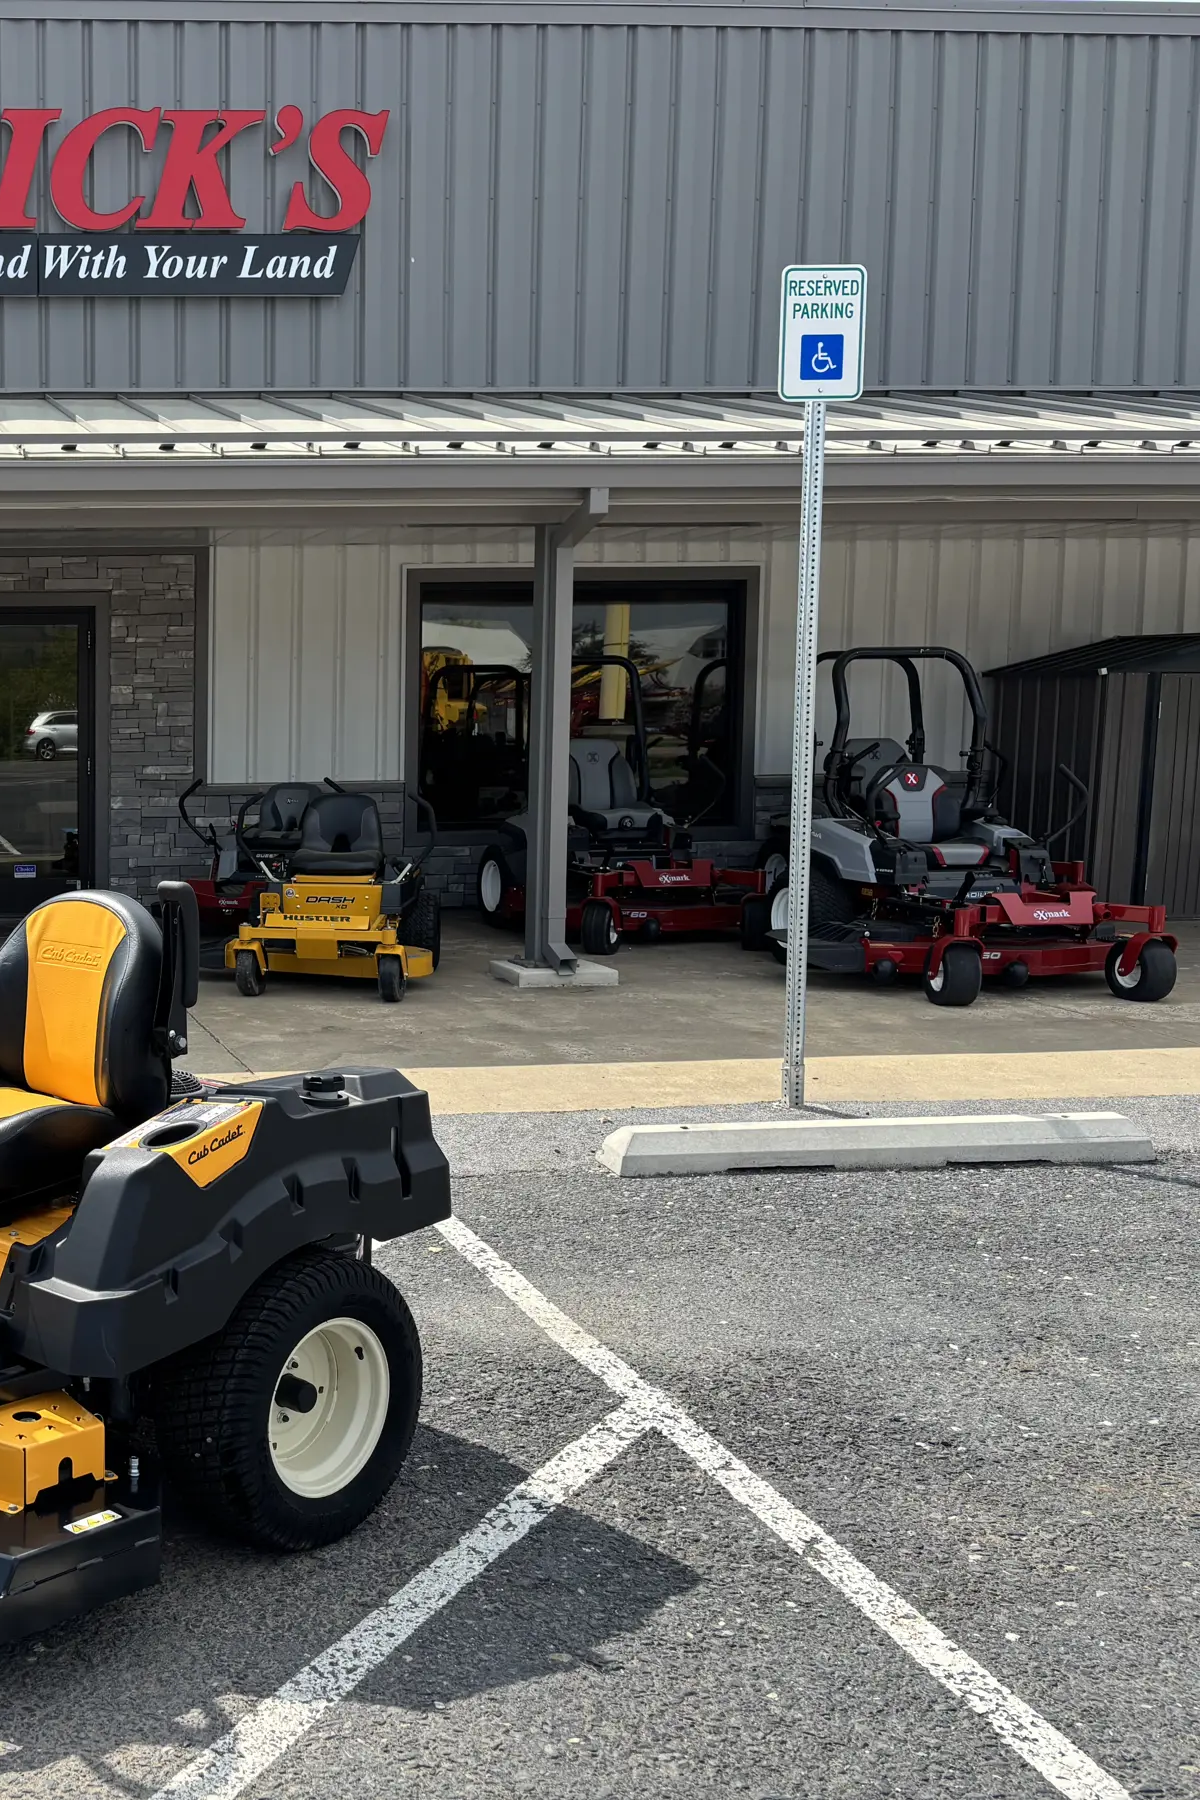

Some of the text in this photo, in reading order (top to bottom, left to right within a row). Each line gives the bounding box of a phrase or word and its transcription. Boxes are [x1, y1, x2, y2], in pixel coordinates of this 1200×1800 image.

[44, 244, 128, 279] With
[143, 245, 228, 279] Your
[237, 245, 338, 279] Land
[788, 279, 860, 296] RESERVED
[792, 302, 854, 319] PARKING
[305, 895, 356, 904] DASH
[283, 914, 351, 923] HUSTLER
[630, 911, 648, 919] 60
[1033, 908, 1071, 921] eXmark
[188, 1124, 244, 1165] Cub Cadet
